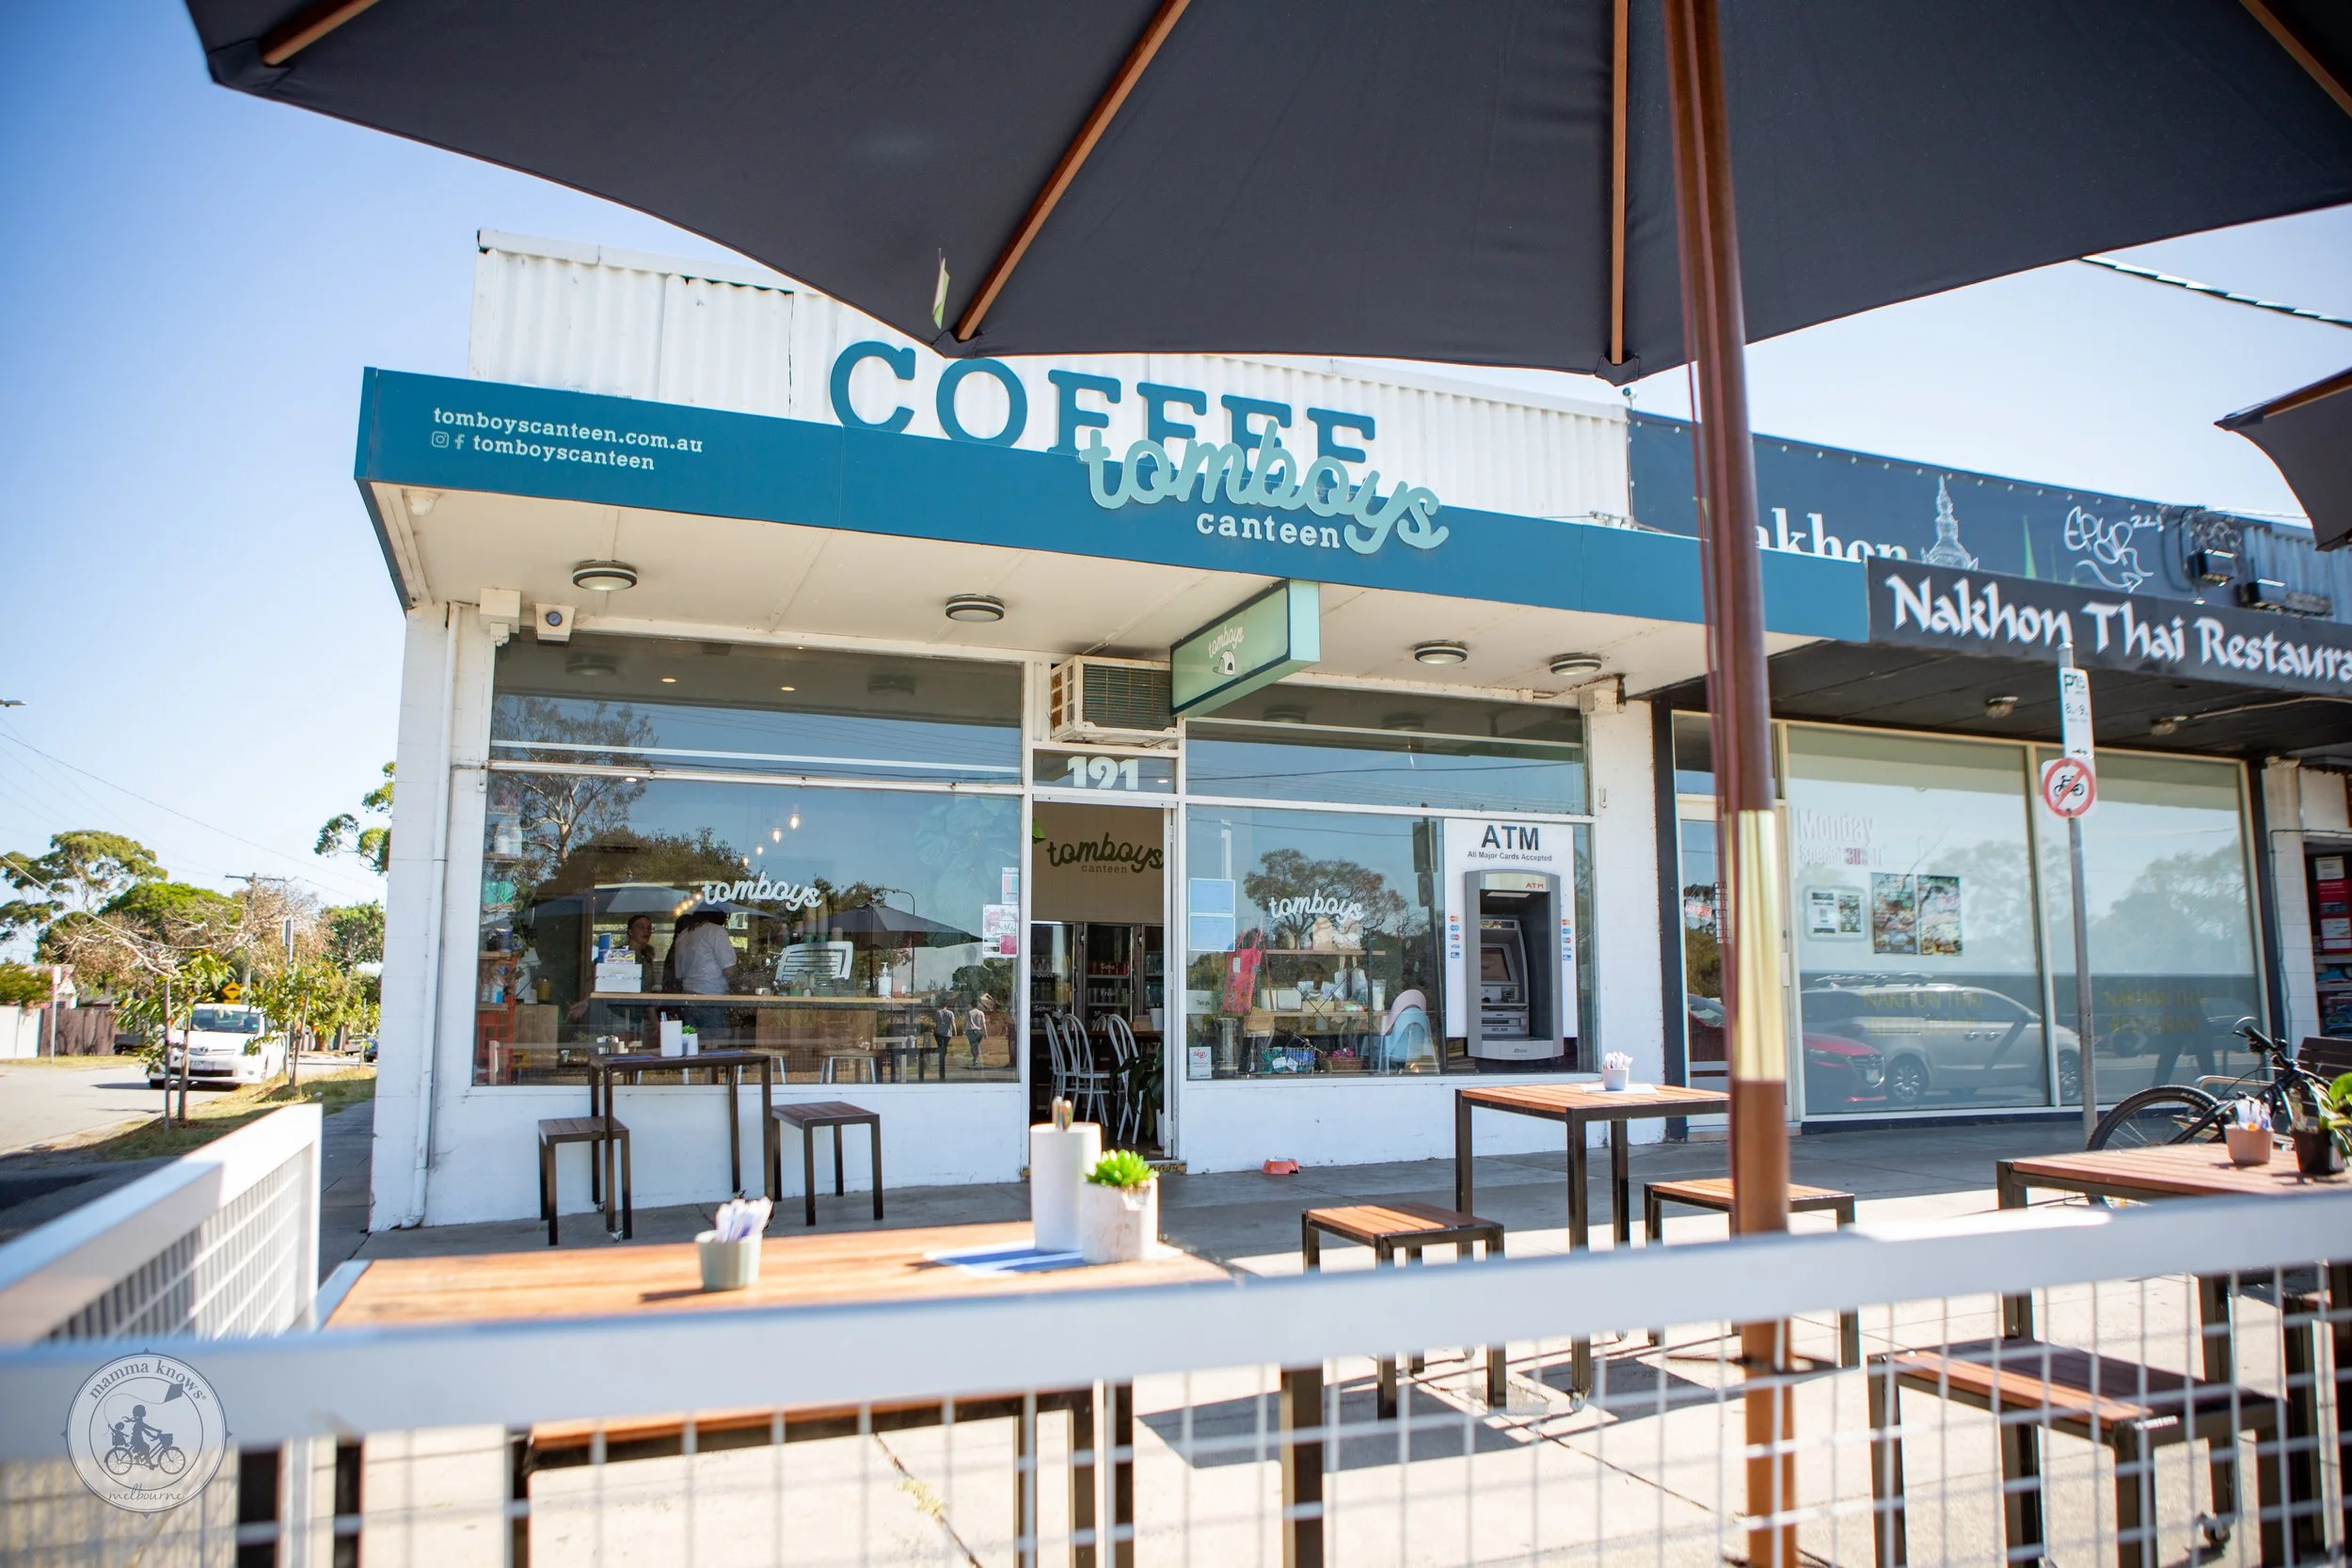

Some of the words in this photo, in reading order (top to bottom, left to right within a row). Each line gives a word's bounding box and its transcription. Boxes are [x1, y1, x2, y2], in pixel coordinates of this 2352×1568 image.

[830, 341, 1375, 478] COFFEE
[433, 406, 704, 453] tomboyscanteen.com.au
[472, 435, 656, 471] tomboyscanteen
[1079, 420, 1450, 555] tomboys
[1196, 512, 1341, 549] canteen
[1883, 574, 2074, 647] Nakhon
[2081, 600, 2185, 662] Thai
[1208, 625, 1244, 658] tomboys
[1067, 755, 1139, 790] 191
[1481, 824, 1539, 851] ATM
[1796, 808, 1875, 846] Monday
[1046, 832, 1164, 874] tomboys
[1081, 864, 1128, 874] canteen
[1478, 851, 1498, 860] Major
[702, 871, 822, 911] tomboys
[1268, 888, 1365, 924] tomboys
